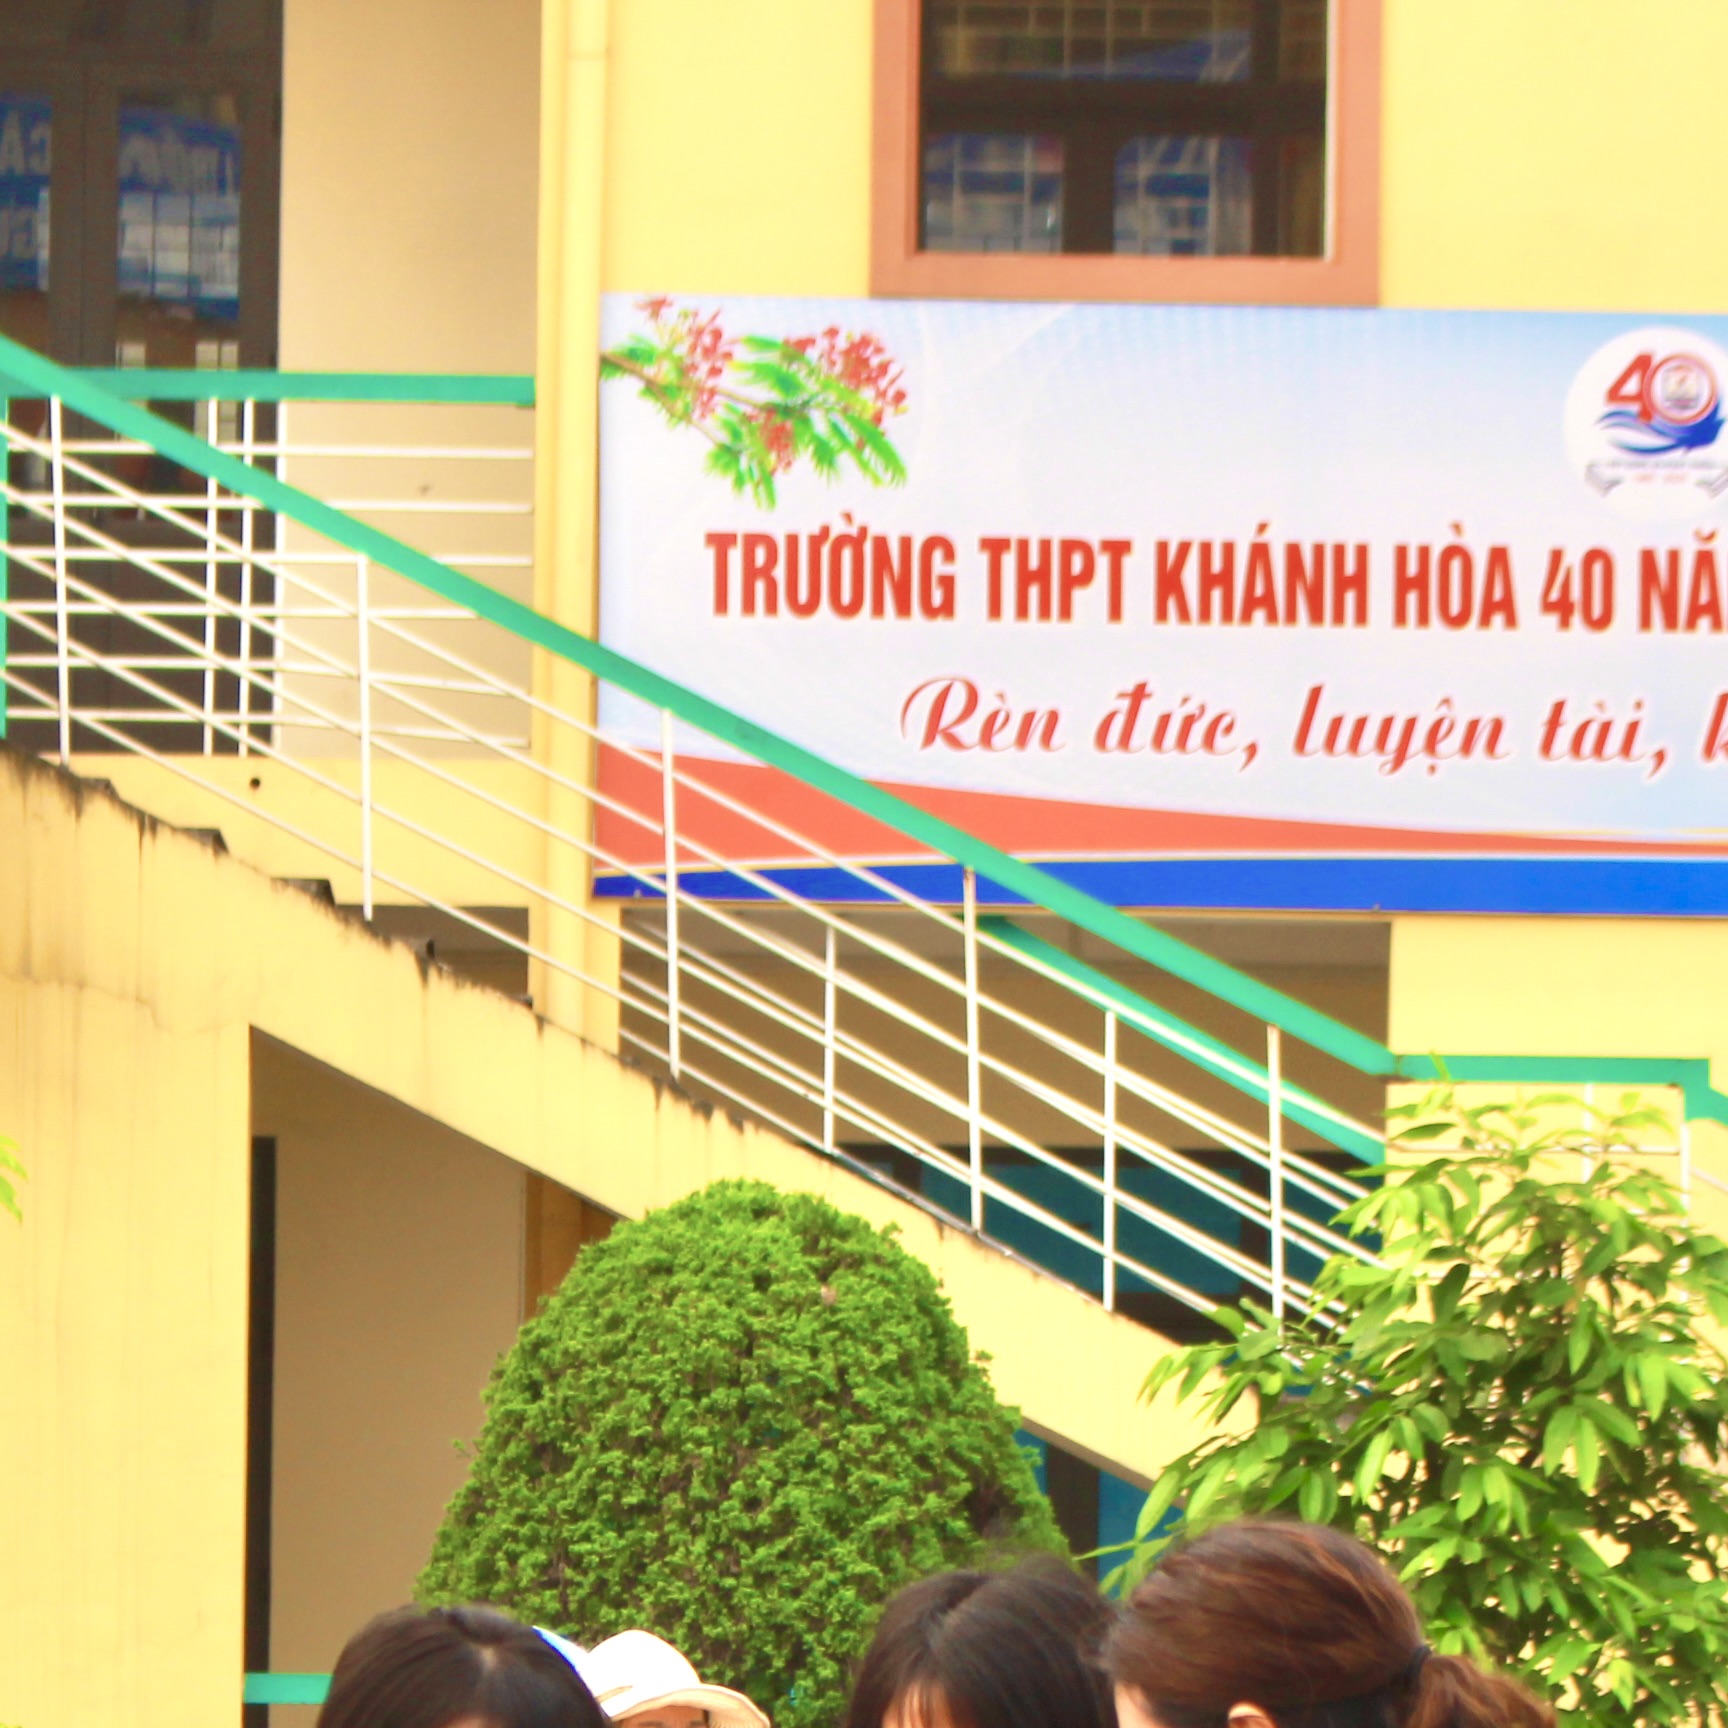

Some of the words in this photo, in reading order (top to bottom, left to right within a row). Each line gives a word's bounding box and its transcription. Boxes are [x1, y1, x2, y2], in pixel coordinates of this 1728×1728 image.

[703, 511, 958, 622] TRƯỜNG
[977, 534, 1134, 625] THPT
[1152, 519, 1371, 629] KHÁNH
[1391, 520, 1520, 631] HÒA
[1538, 546, 1617, 634] 40
[900, 675, 1064, 753] Rèn
[1092, 680, 1260, 772] đức,
[1291, 683, 1510, 776] luyện
[1537, 698, 1668, 775] tài,
